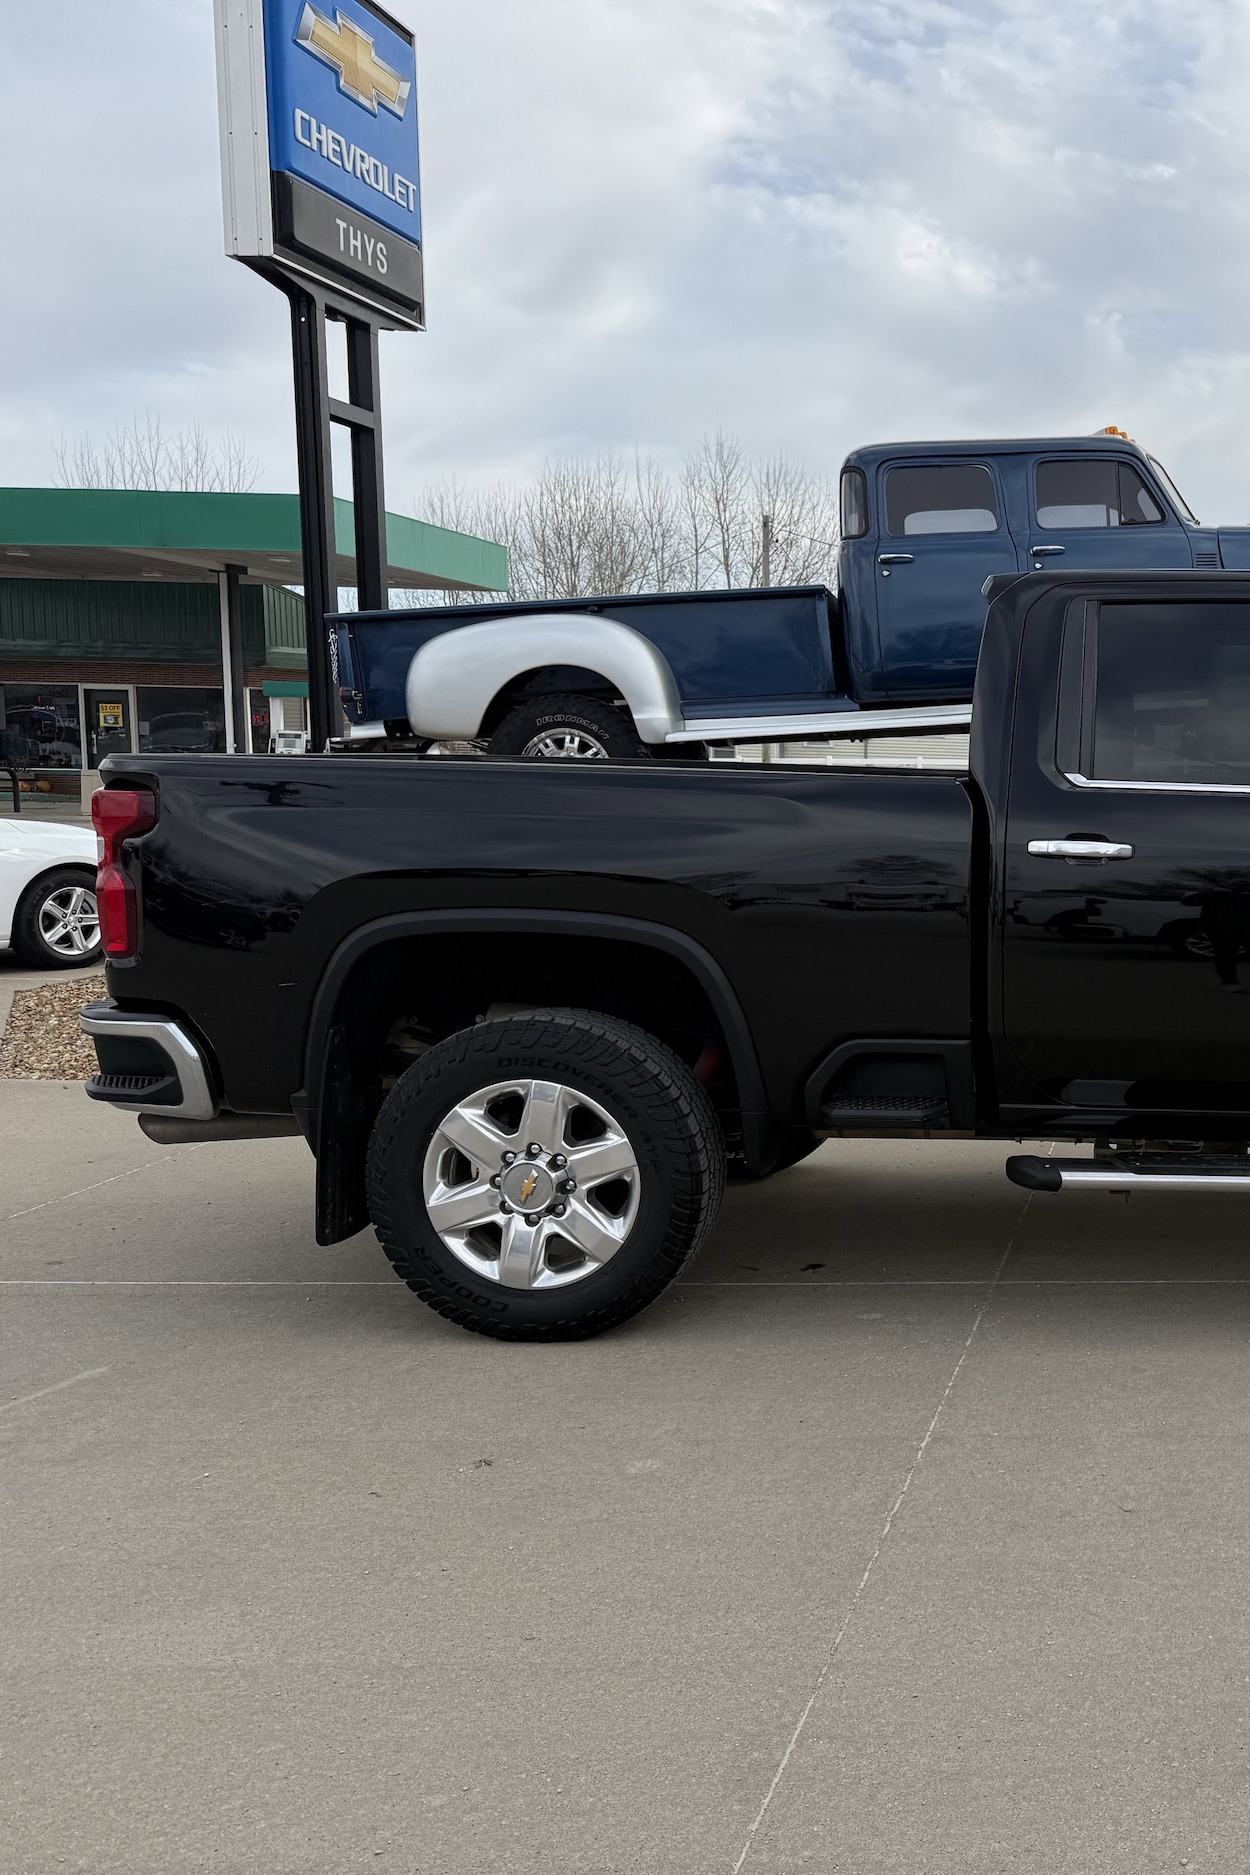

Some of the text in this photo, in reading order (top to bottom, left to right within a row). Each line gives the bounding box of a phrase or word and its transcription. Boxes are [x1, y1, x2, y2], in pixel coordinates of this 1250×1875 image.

[294, 107, 417, 213] CHEVROLET
[335, 217, 388, 275] THYS
[536, 714, 610, 739] IRONMAN
[497, 1057, 637, 1118] DISCOVERER
[414, 1246, 510, 1312] COOPER
